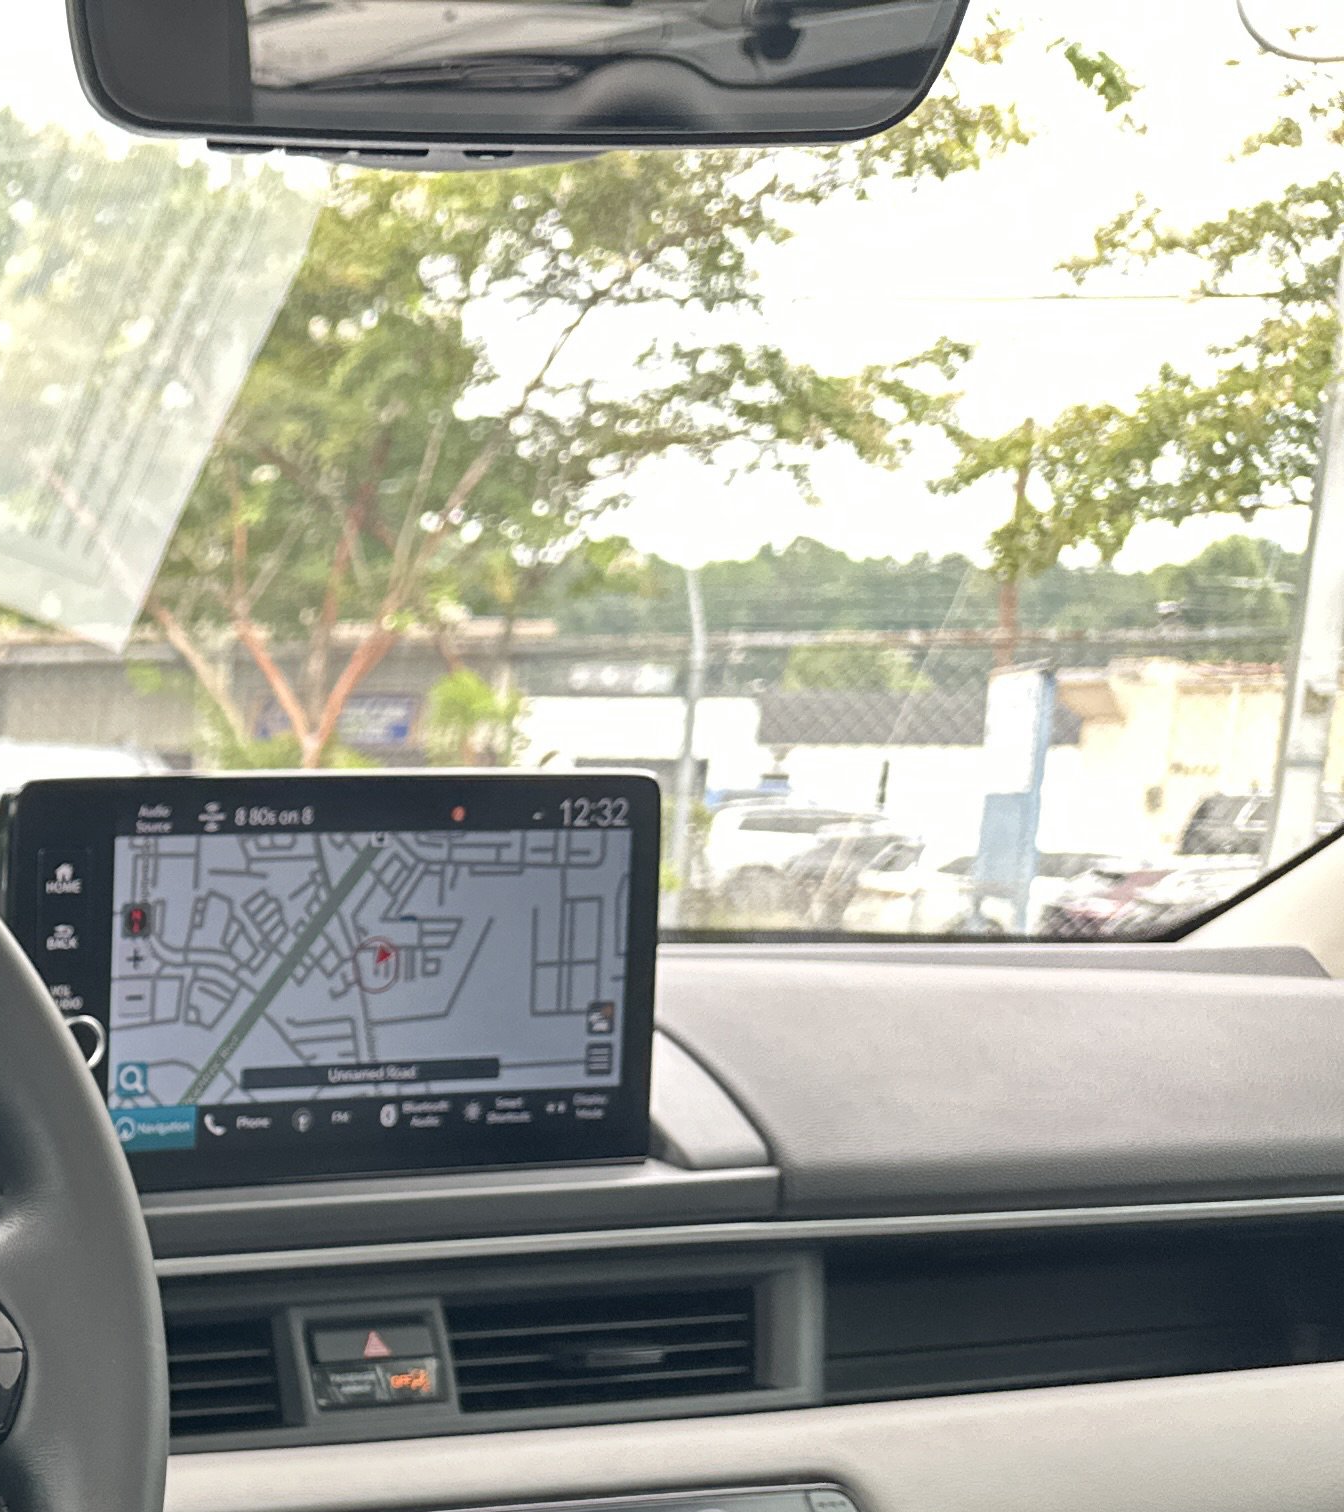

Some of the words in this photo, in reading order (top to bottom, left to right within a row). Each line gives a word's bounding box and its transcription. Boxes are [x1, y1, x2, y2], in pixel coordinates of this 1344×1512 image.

[279, 809, 300, 825] on
[559, 797, 630, 828] 12:32
[45, 879, 83, 894] HOME
